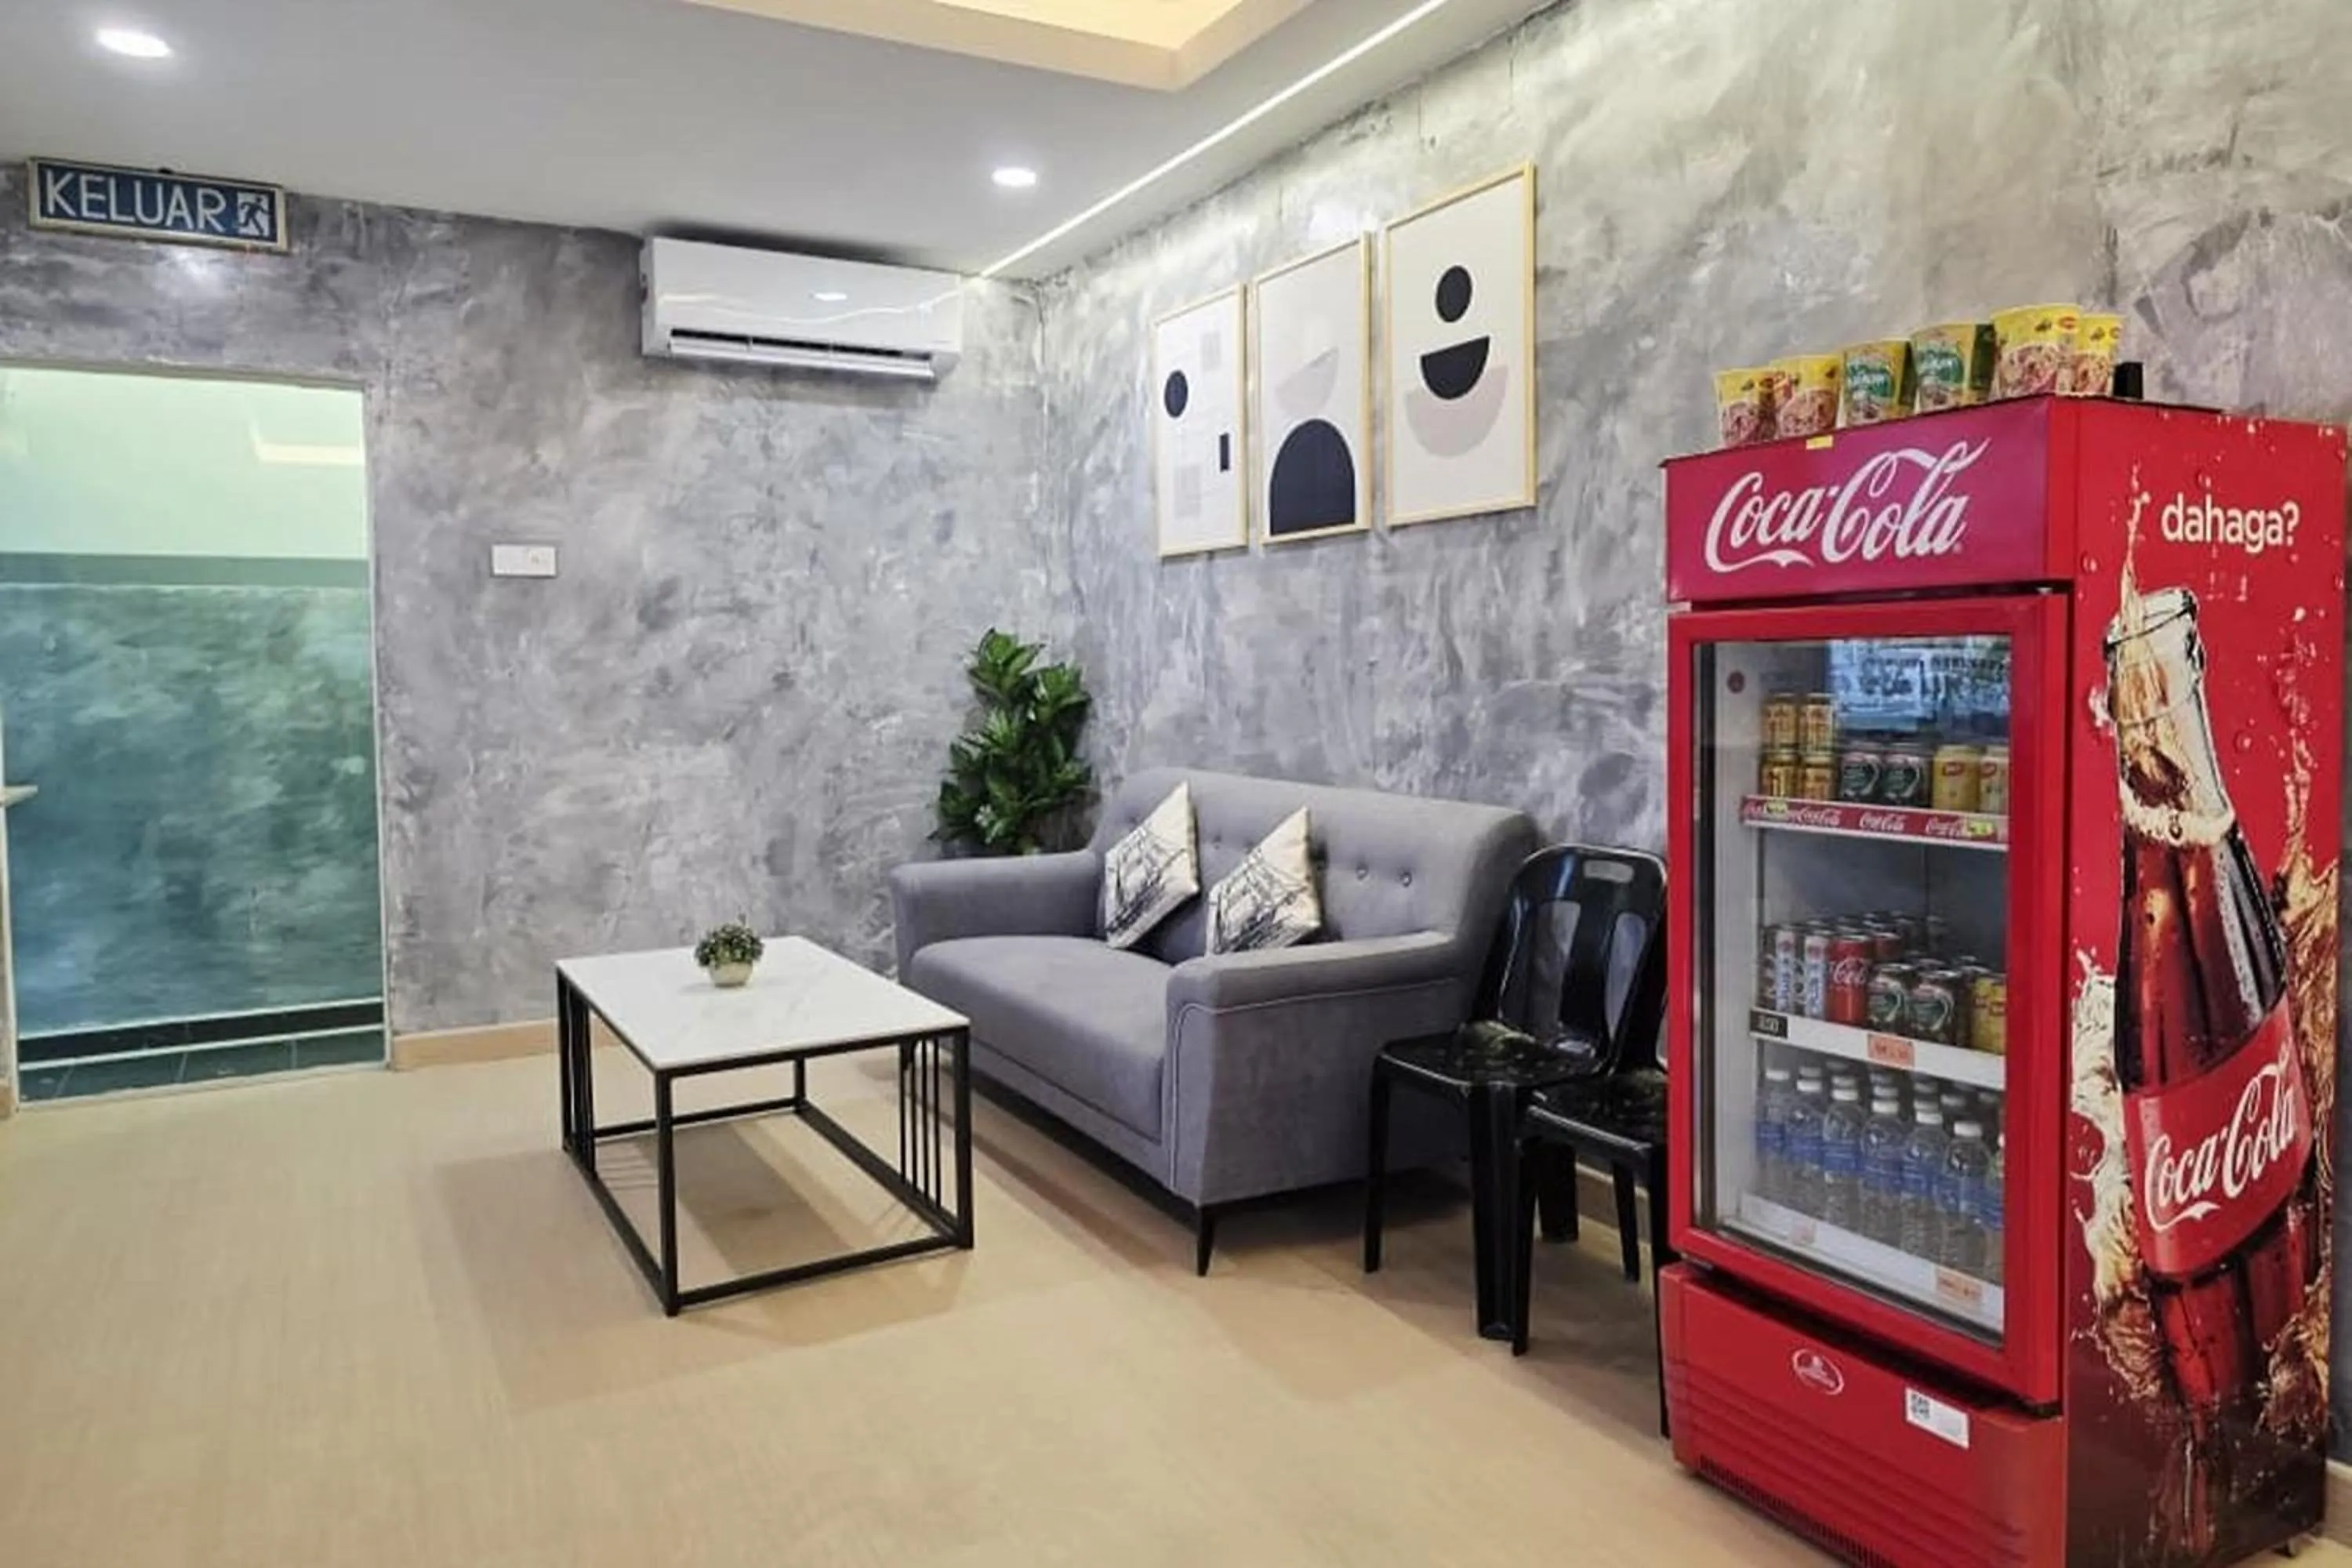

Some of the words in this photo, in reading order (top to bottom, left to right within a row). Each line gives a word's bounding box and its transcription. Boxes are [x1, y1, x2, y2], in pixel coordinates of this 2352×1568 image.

[45, 169, 227, 233] KELUAR
[1704, 437, 1992, 573] Coca-Cola
[2161, 492, 2299, 554] dahaga?
[2144, 1036, 2298, 1232] Coca-Cola
